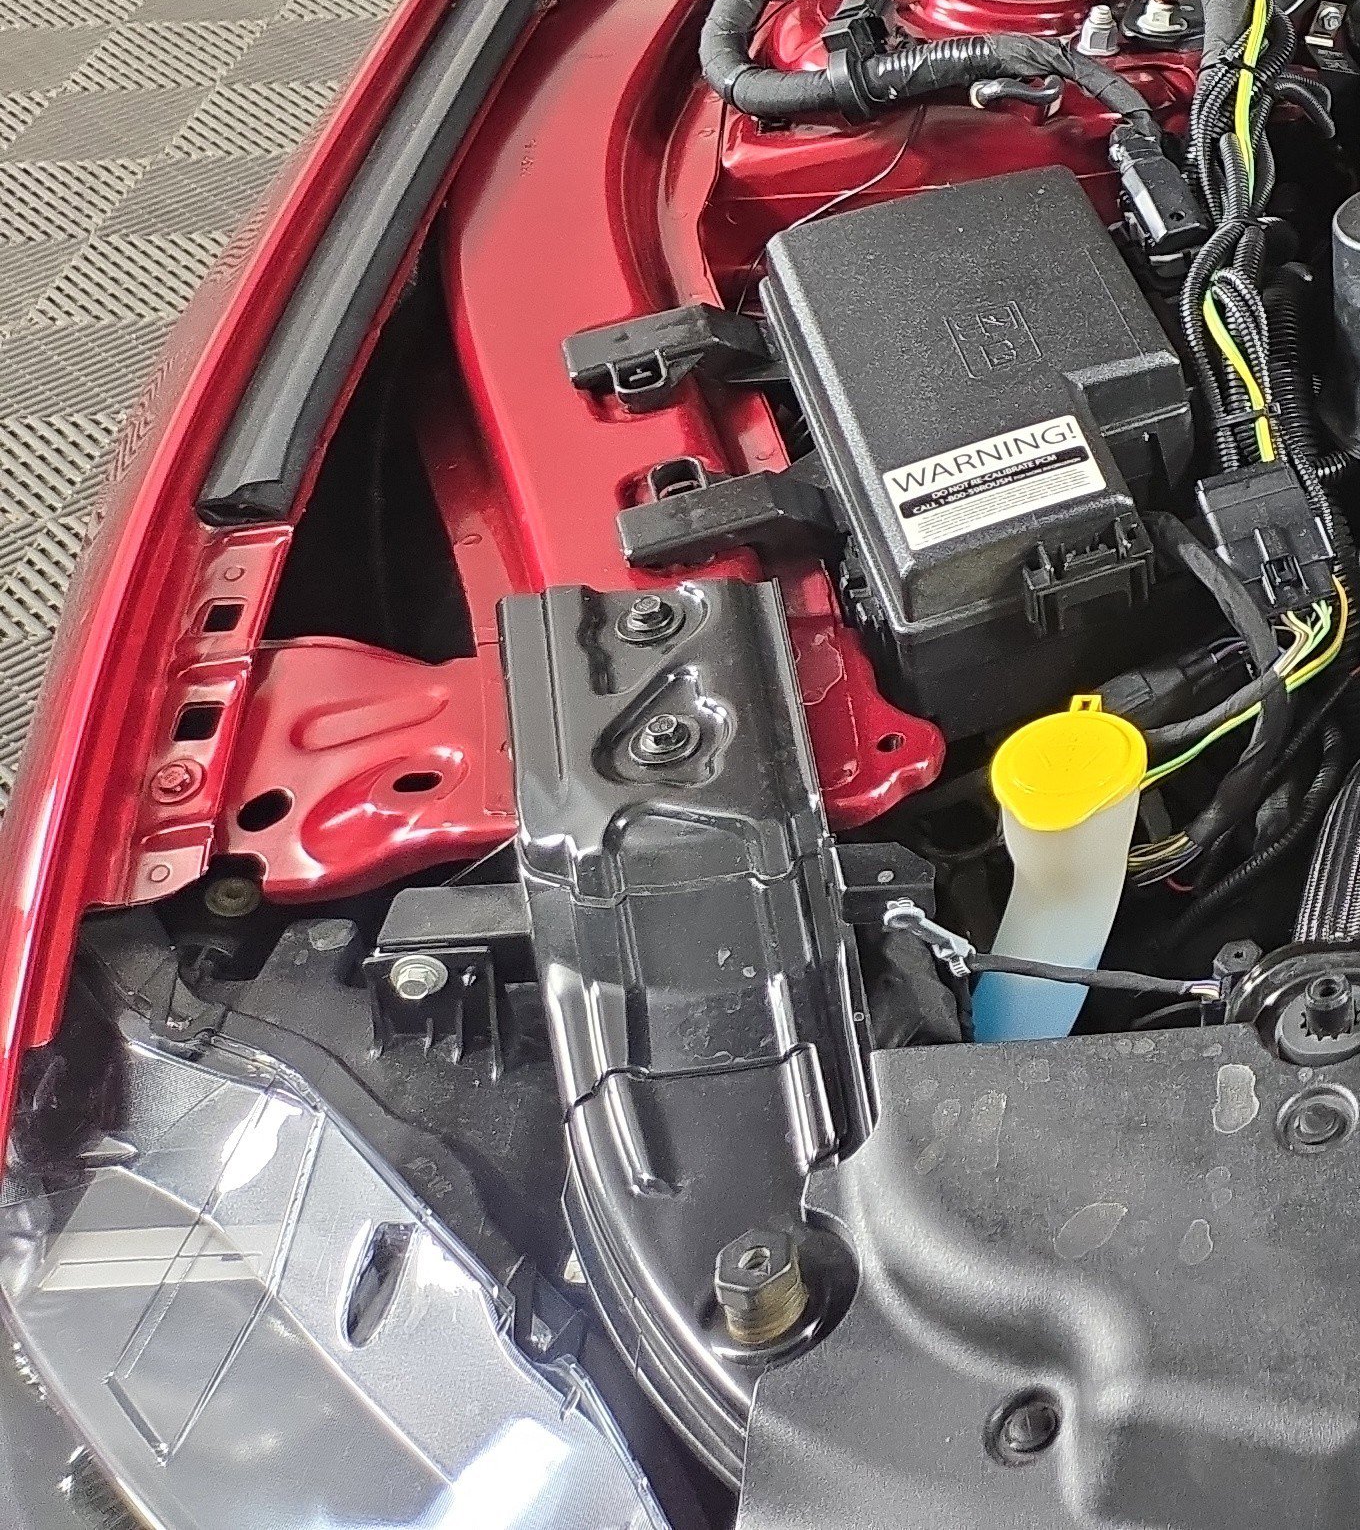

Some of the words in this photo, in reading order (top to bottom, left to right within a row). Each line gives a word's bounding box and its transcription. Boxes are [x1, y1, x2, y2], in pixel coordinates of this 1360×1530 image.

[892, 422, 1077, 492] WARNING!
[932, 488, 948, 500] DO
[949, 481, 970, 494] NOT
[970, 461, 1035, 486] RE-CALIBRATE
[1035, 454, 1058, 466] PCM
[913, 498, 939, 514] CALL
[939, 475, 1013, 505] 1-800-59ROUSH
